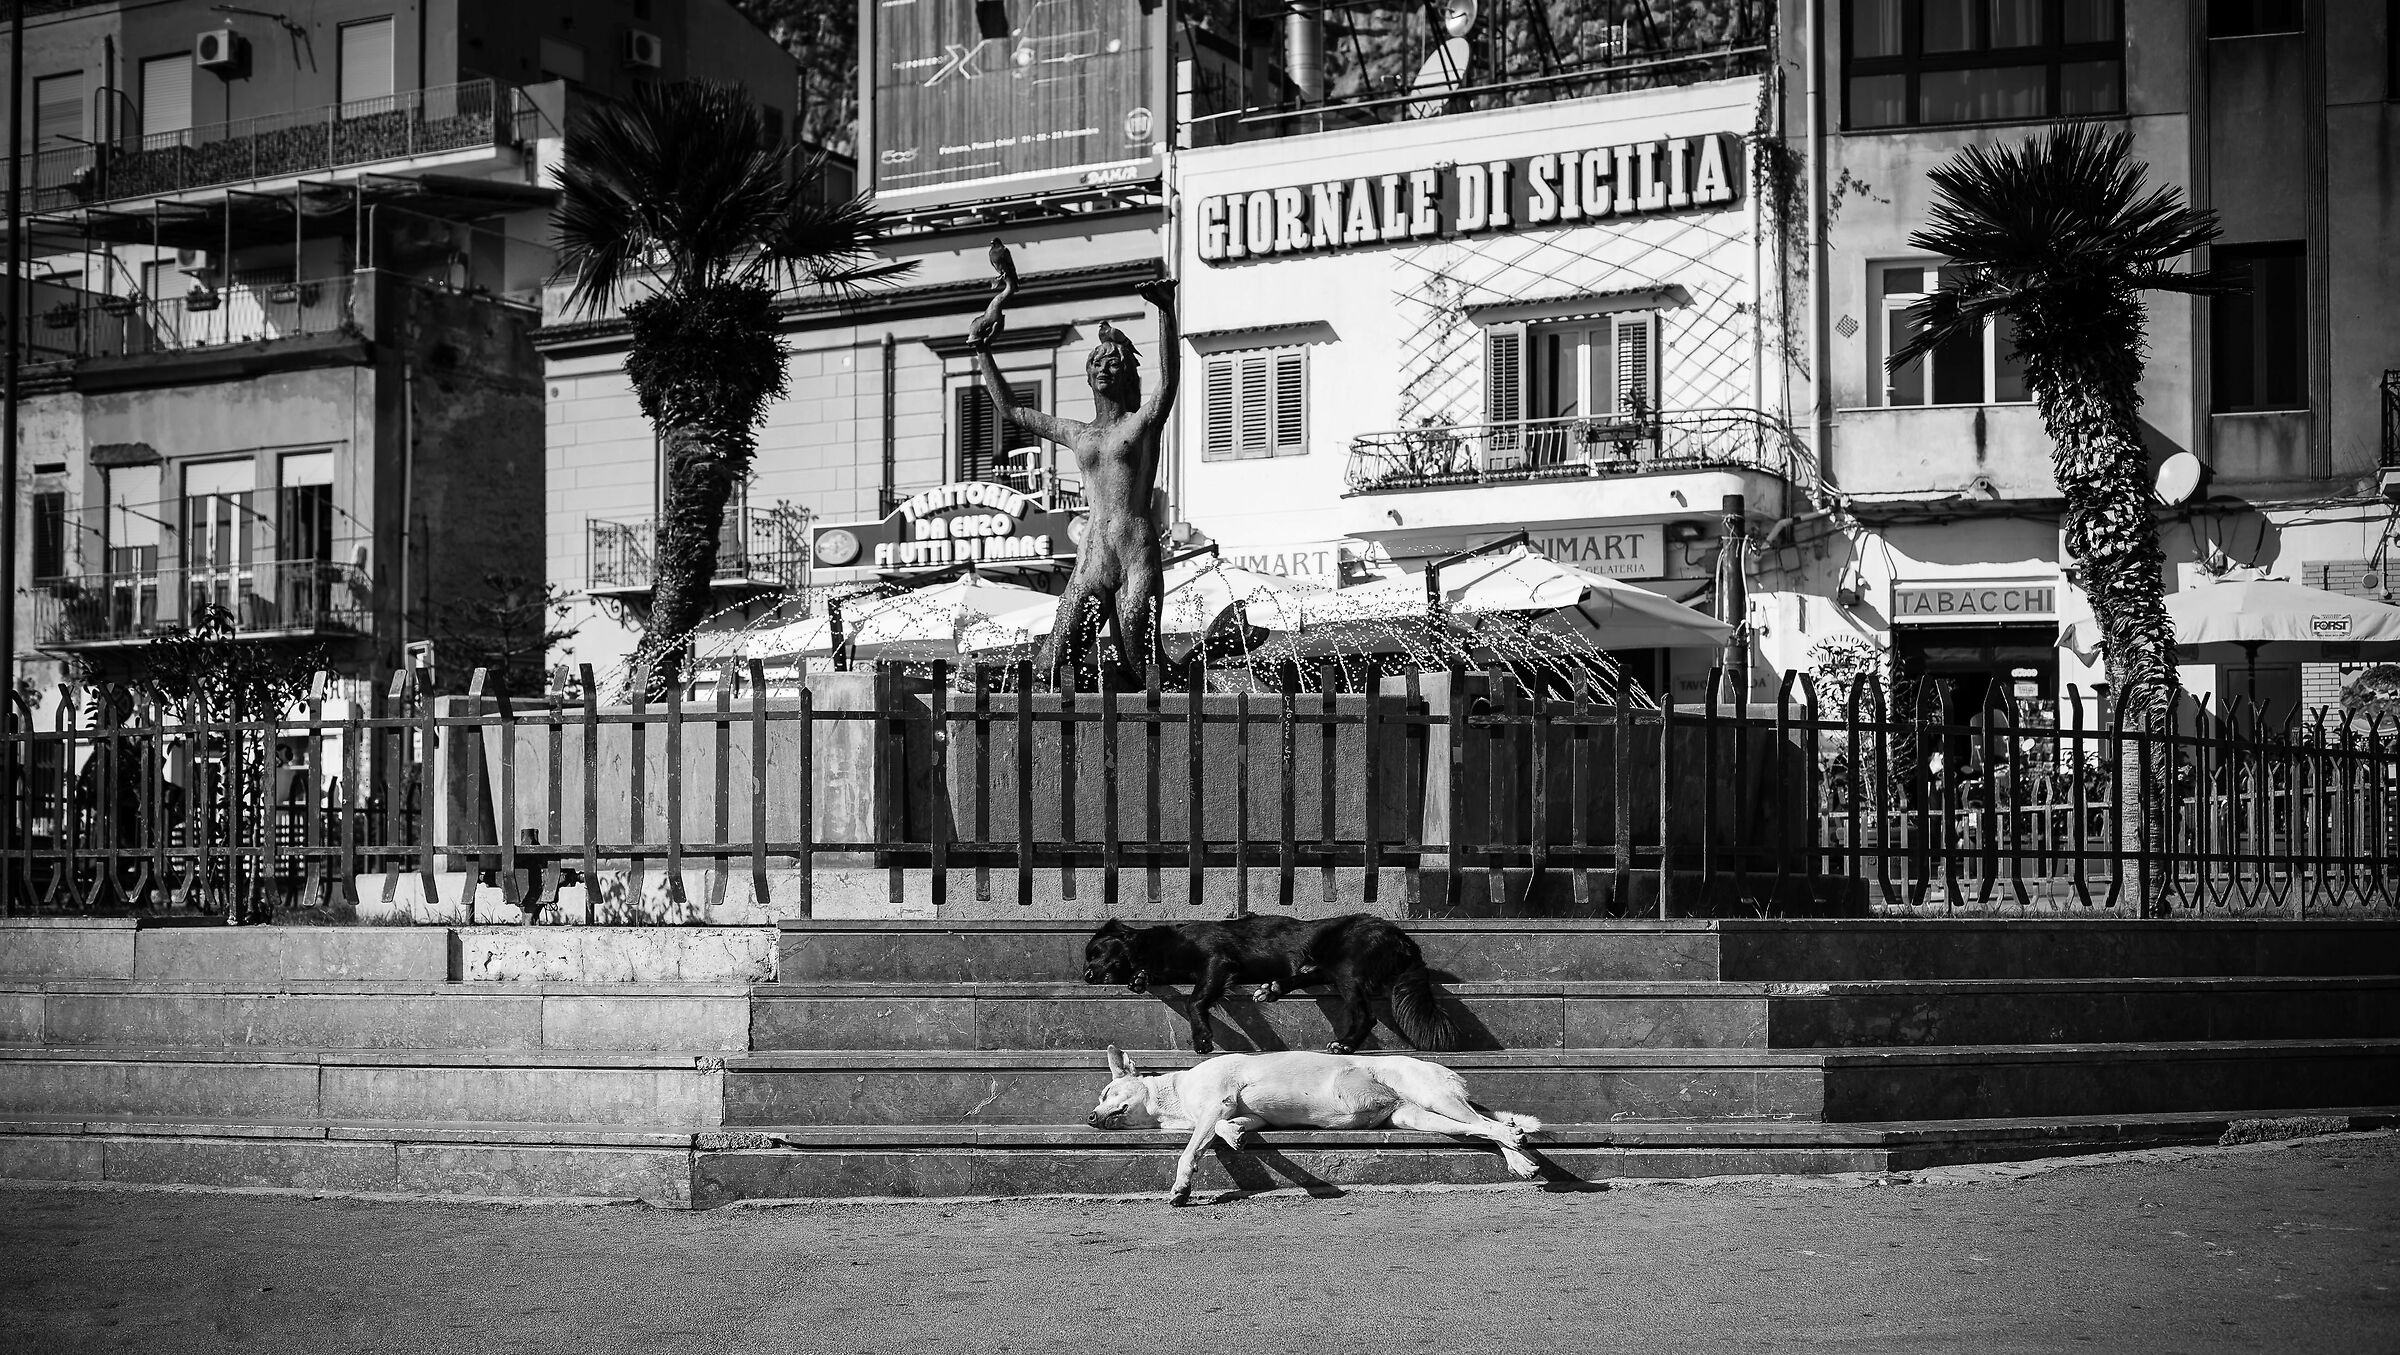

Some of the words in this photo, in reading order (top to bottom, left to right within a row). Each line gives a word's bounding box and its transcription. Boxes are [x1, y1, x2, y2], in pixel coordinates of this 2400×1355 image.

[1199, 169, 1441, 262] GIORNALE
[1456, 160, 1511, 231] DI
[1528, 134, 1734, 224] SICILIA
[899, 483, 1026, 523] TRATTORIA
[915, 517, 948, 540] DA
[949, 513, 1012, 538] ENZO
[954, 537, 982, 561] DI
[984, 534, 1050, 560] MARE
[1485, 533, 1645, 562] NIMART
[1897, 589, 2053, 613] TABACCHI
[2313, 620, 2349, 631] FORST
